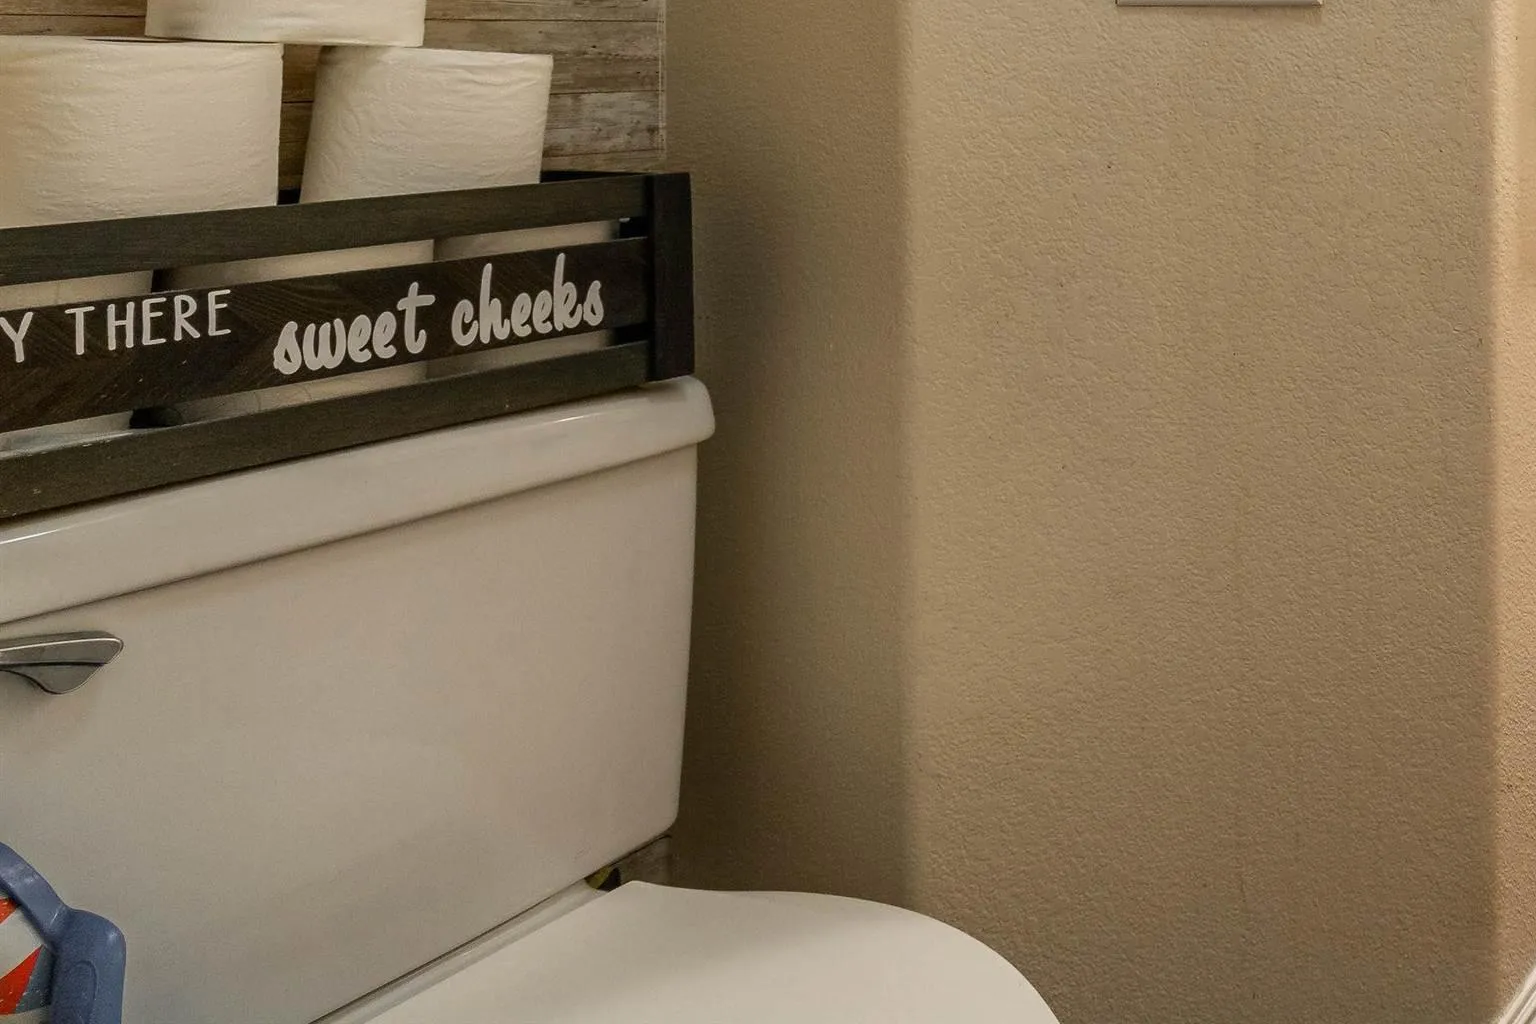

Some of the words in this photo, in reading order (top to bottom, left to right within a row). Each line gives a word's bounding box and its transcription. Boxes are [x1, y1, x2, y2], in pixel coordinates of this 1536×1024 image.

[64, 288, 232, 356] THERE
[273, 281, 436, 375] sweet
[451, 252, 604, 347] cheeks
